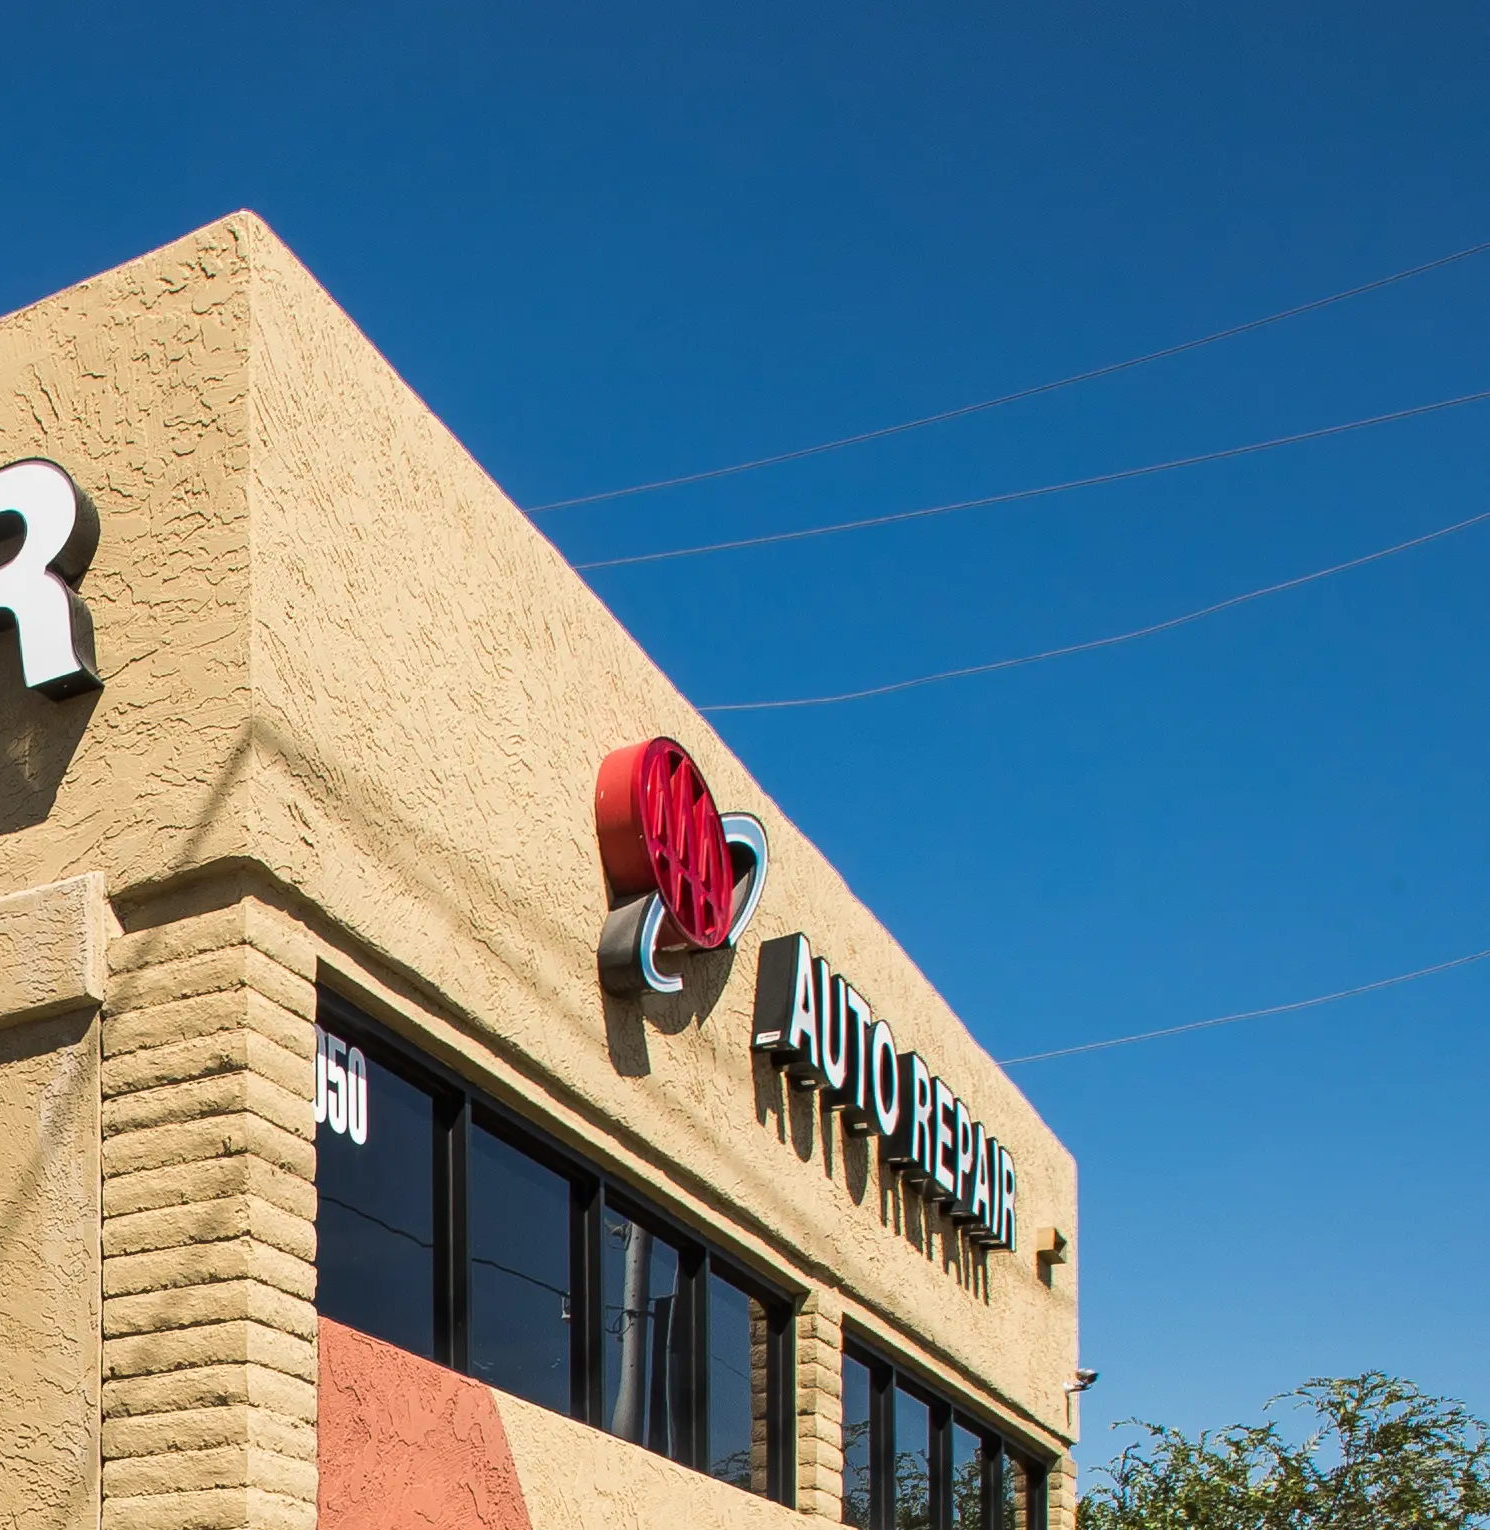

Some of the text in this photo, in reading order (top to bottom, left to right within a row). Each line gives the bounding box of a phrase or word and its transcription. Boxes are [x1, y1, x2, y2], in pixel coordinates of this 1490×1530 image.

[639, 737, 734, 948] AAA
[789, 933, 1017, 1253] AUTO REPAIR
